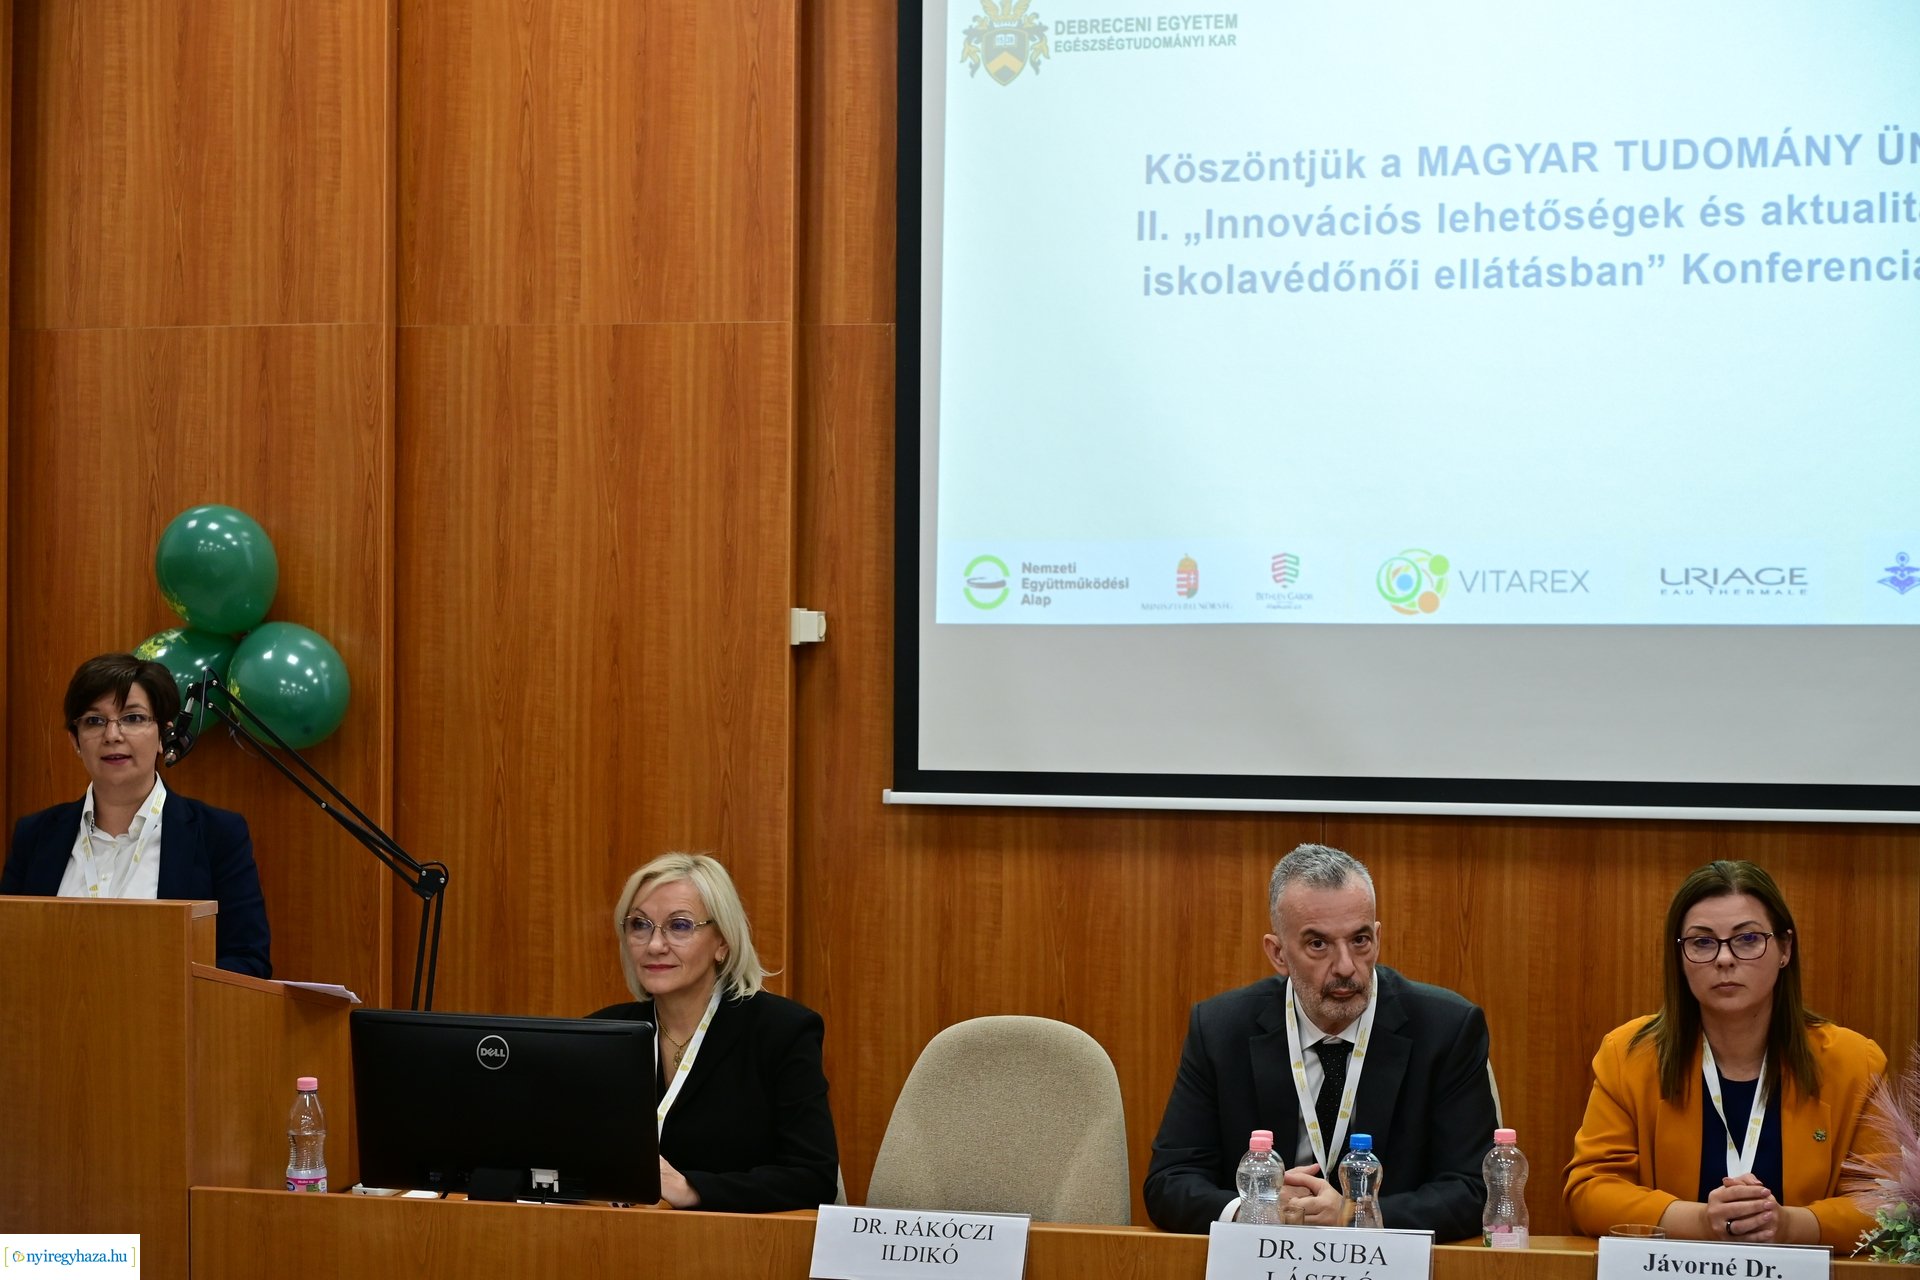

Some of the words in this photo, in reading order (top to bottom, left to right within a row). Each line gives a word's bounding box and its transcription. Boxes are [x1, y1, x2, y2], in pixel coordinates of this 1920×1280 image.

[1055, 17, 1151, 35] DEBRECENI
[1157, 14, 1237, 31] EGYETEM
[1055, 35, 1204, 52] EGÉSZSÉGTUDOMÁNYI
[1209, 34, 1236, 46] KAR
[1146, 149, 1366, 187] Köszöntjük
[1381, 154, 1401, 177] a
[1419, 141, 1599, 176] MAGYAR
[1615, 127, 1863, 171] TUDOMÁNY
[1138, 210, 1168, 241] II.
[1439, 197, 1684, 237] lehetőségek
[1700, 195, 1745, 227] és
[1762, 191, 1920, 225] aktualit
[1144, 259, 1418, 296] iskolavédőnői
[1022, 562, 1076, 574] Nemzeti
[1661, 567, 1808, 587] URIAGE
[1022, 577, 1129, 592] Együttműködési
[1459, 570, 1589, 593] VITAREX
[1021, 594, 1051, 608] Alap
[1708, 588, 1807, 596] THERMALE
[480, 1048, 506, 1057] DELL
[853, 1218, 886, 1234] DR.
[895, 1216, 994, 1241] RÁKÓCZI
[882, 1244, 958, 1264] ILDIKÓ
[1259, 1239, 1302, 1260] DR.
[1313, 1242, 1387, 1265] SUBA
[1643, 1254, 1737, 1276] Jávorné
[1747, 1259, 1782, 1279] Dr.
